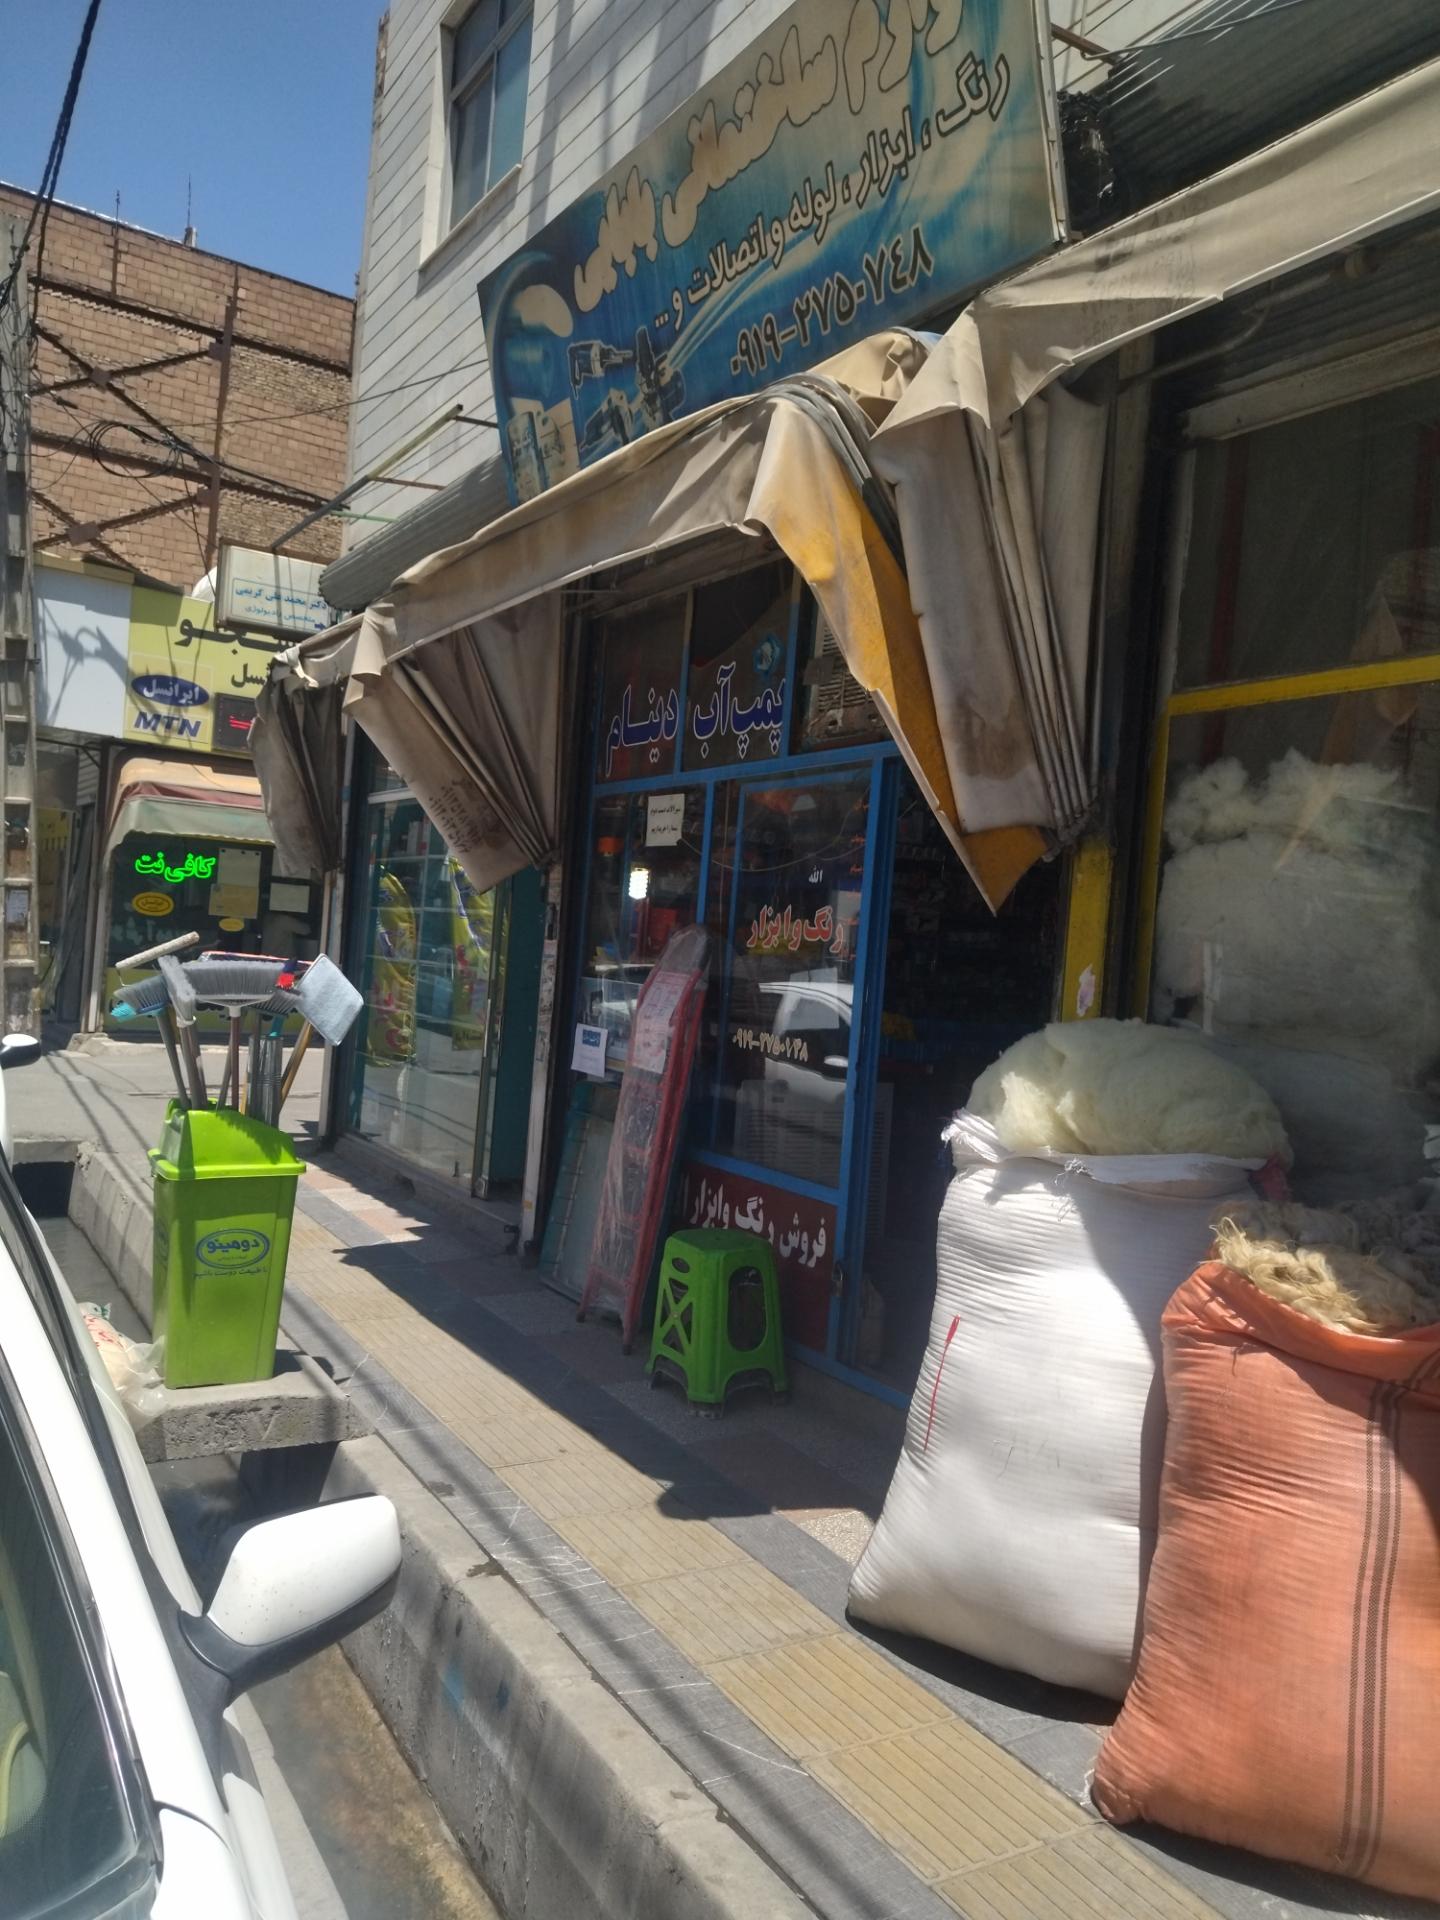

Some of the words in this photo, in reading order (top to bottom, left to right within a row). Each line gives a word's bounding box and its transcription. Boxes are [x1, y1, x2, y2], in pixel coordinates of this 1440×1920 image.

[661, 23, 839, 248] ساختمانی
[788, 161, 837, 246] لوله
[687, 212, 766, 304] اتصالات
[770, 216, 786, 270] و
[143, 679, 200, 705] ایرانسل
[693, 661, 737, 760] آب
[730, 677, 786, 760] پمپ
[134, 711, 202, 738] MTN
[605, 684, 679, 778] دینام
[135, 851, 165, 874] نت
[164, 853, 216, 882] کافی
[747, 904, 793, 949] ابزار
[803, 905, 844, 953] رنگ
[207, 1238, 260, 1254] دومینو
[779, 1212, 827, 1268] فروش
